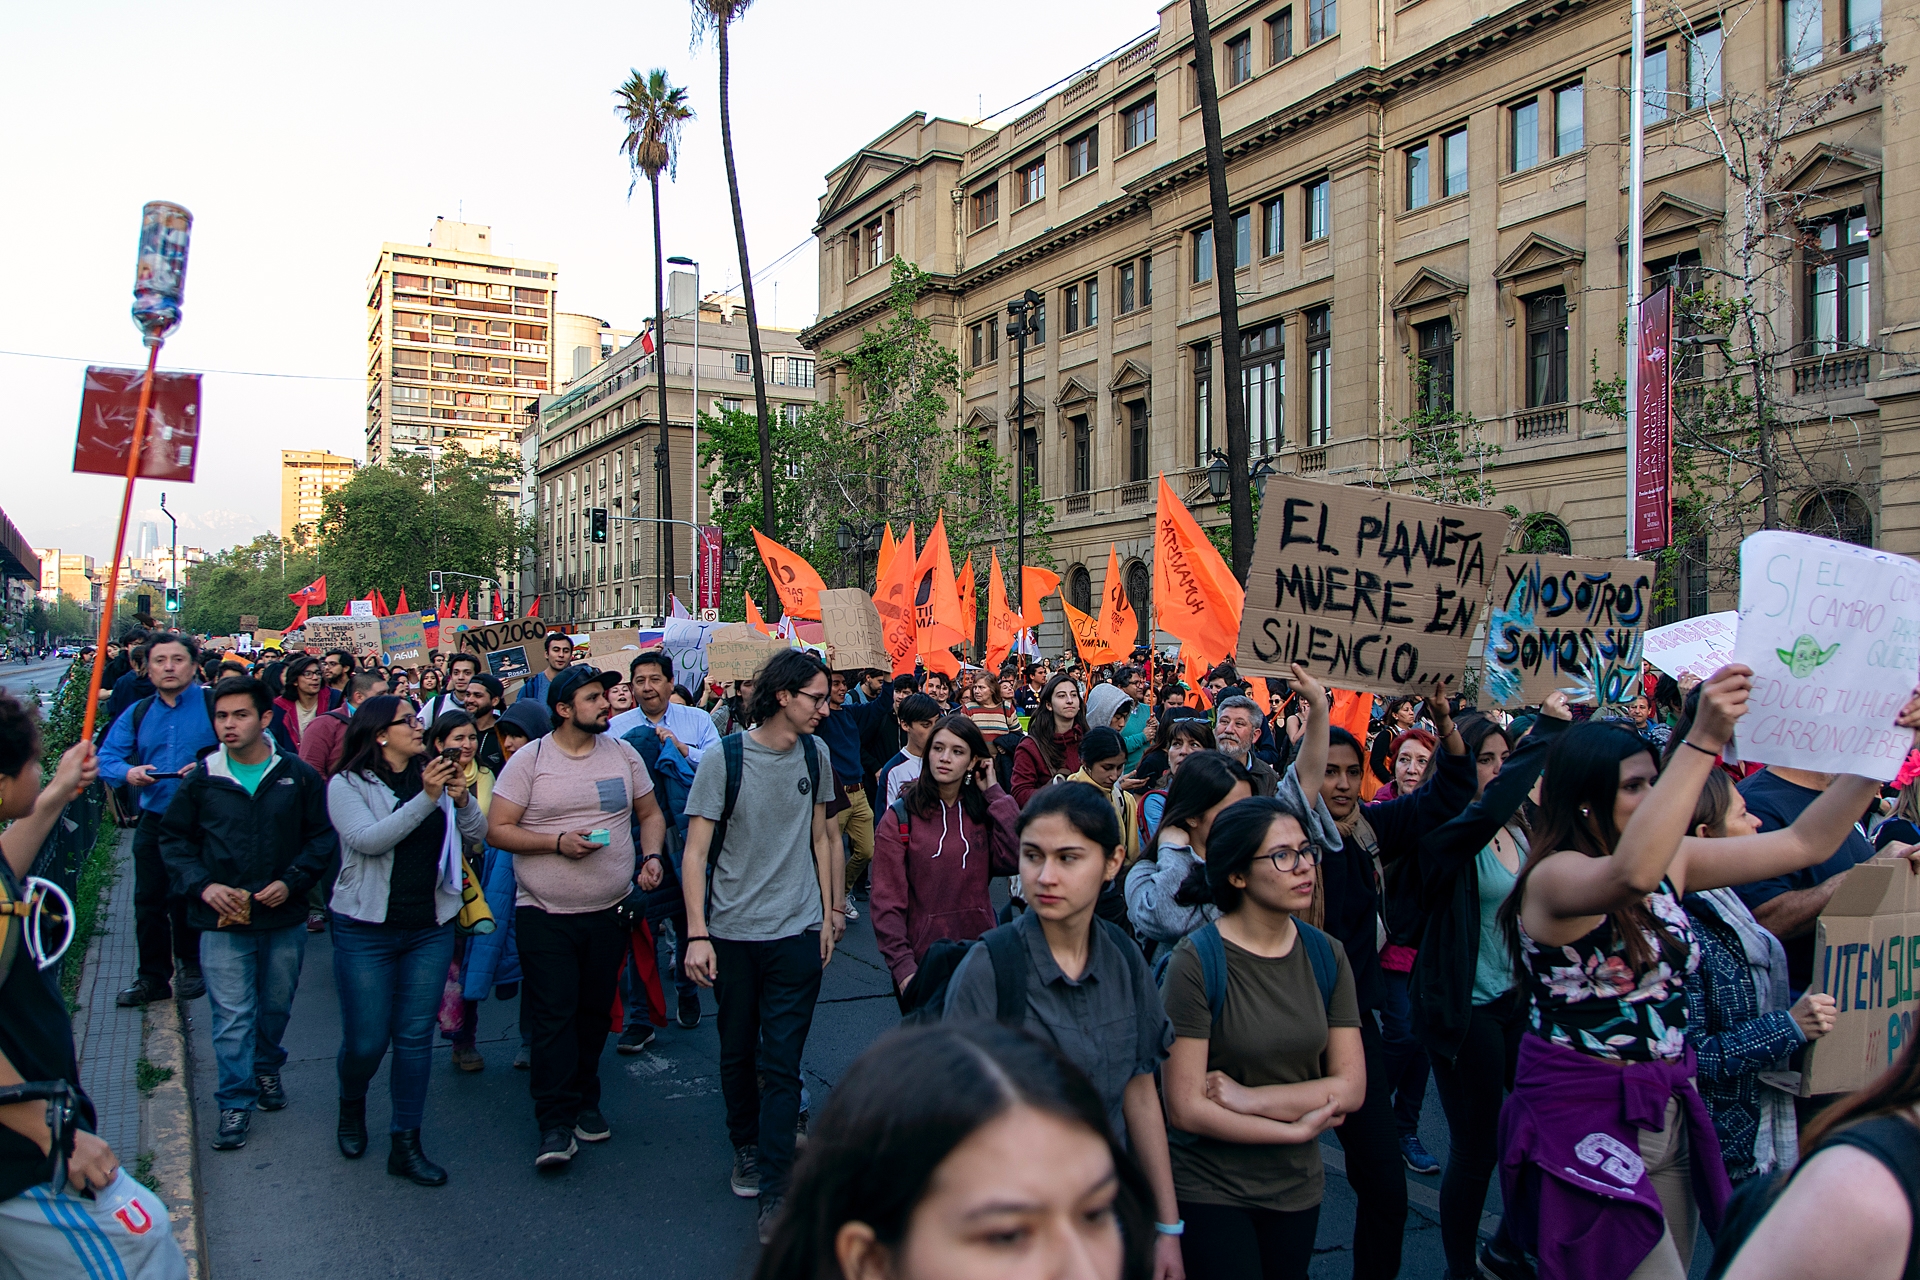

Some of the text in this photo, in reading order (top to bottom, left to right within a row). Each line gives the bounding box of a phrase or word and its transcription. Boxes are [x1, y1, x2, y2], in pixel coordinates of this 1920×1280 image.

[1280, 498, 1484, 588] EL PLANETA
[1764, 554, 1803, 626] SI
[1816, 561, 1844, 586] EL
[833, 589, 863, 607] NO
[1275, 564, 1476, 637] MUERE EN
[1808, 594, 1886, 633] CAMBIO
[500, 620, 546, 645] 2060
[1497, 626, 1594, 677] SOMOS
[394, 649, 419, 661] AGUA
[1592, 656, 1640, 706] VOZ
[1833, 689, 1861, 714] TU
[1823, 939, 1885, 1013] UTEM
[113, 1198, 153, 1235] U
